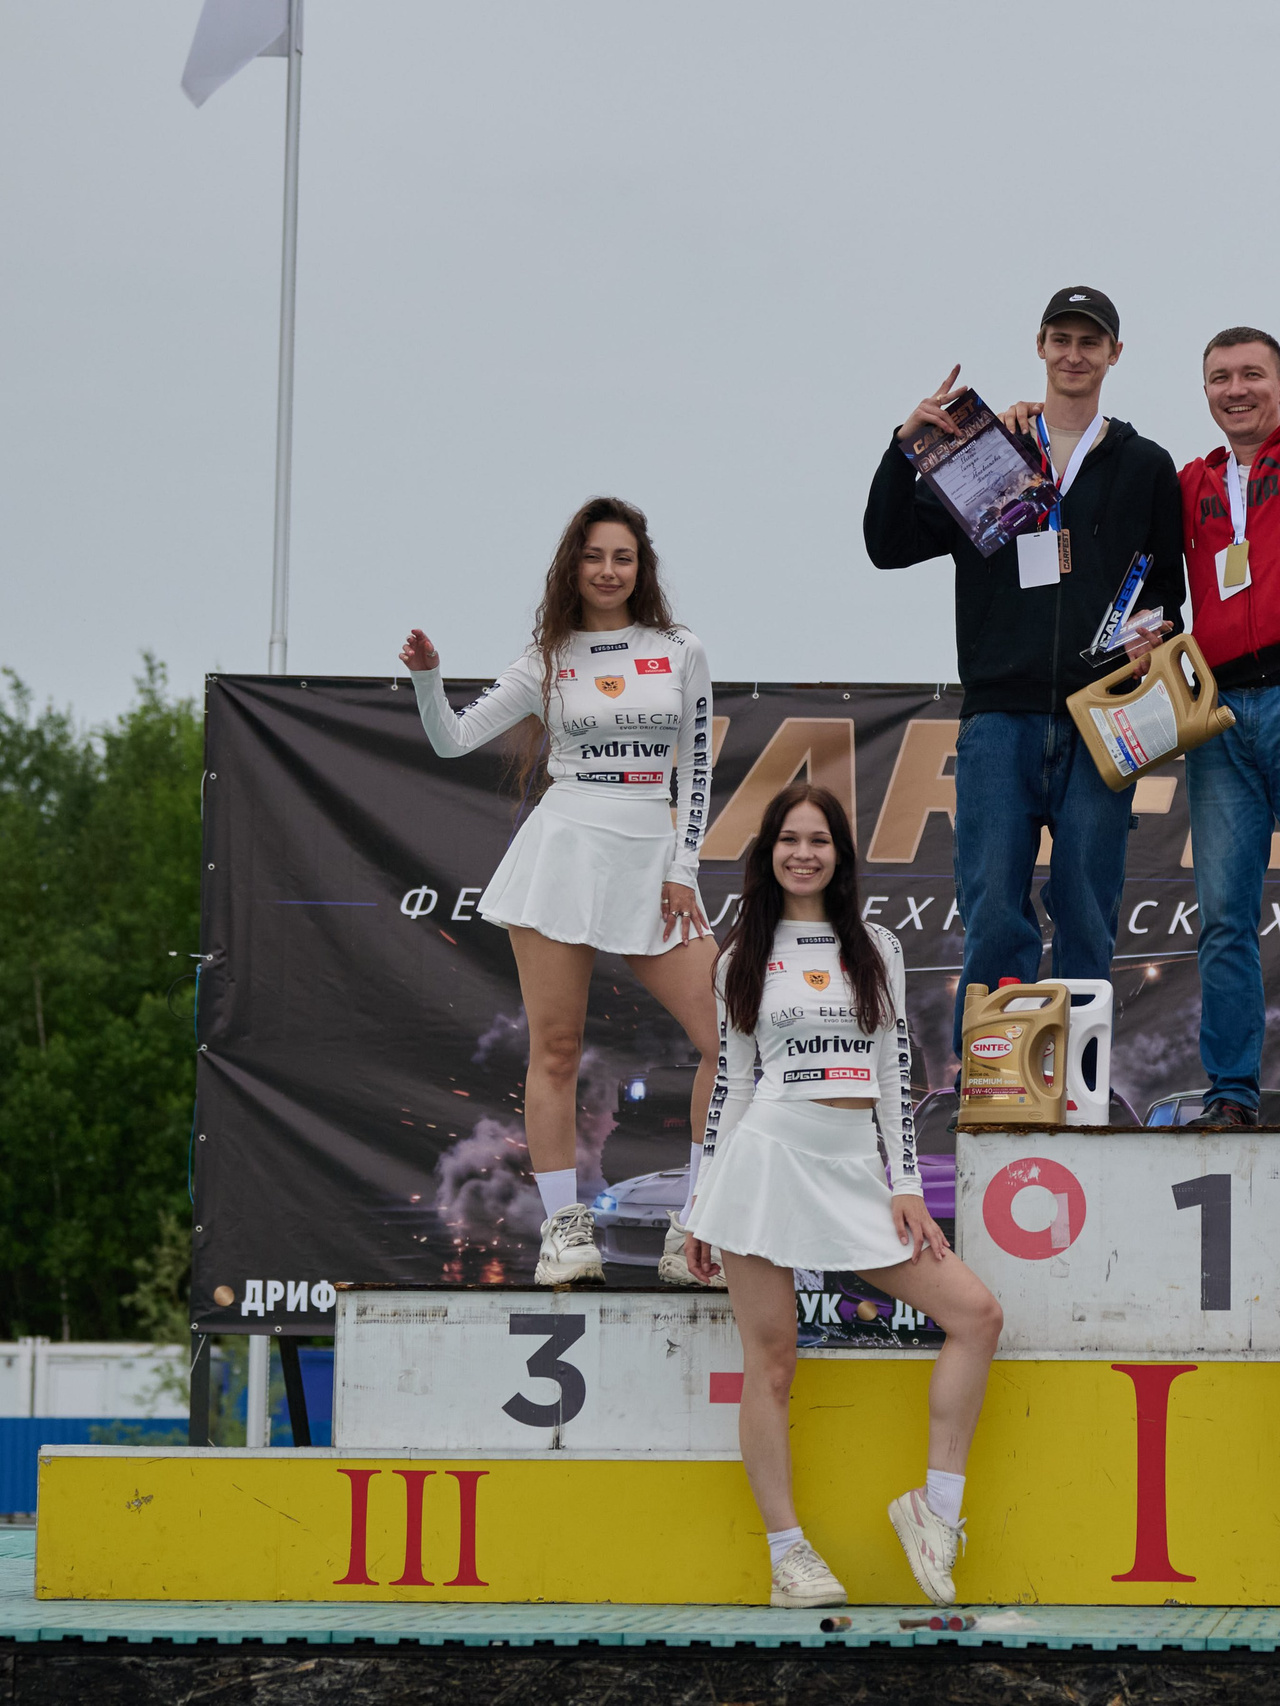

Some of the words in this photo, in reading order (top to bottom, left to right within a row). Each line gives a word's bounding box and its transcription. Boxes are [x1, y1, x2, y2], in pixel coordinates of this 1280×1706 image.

[913, 398, 975, 455] CAREST
[1100, 564, 1143, 648] CARFEST
[628, 774, 662, 782] GOLD
[785, 1070, 822, 1081] EVGO
[829, 1070, 868, 1079] GOLD
[973, 1043, 1010, 1051] SINTEC
[1171, 1173, 1232, 1311] 1
[240, 1278, 338, 1317] ДРИФ
[501, 1314, 587, 1428] 3
[1111, 1364, 1198, 1583] I
[332, 1468, 490, 1587] III
